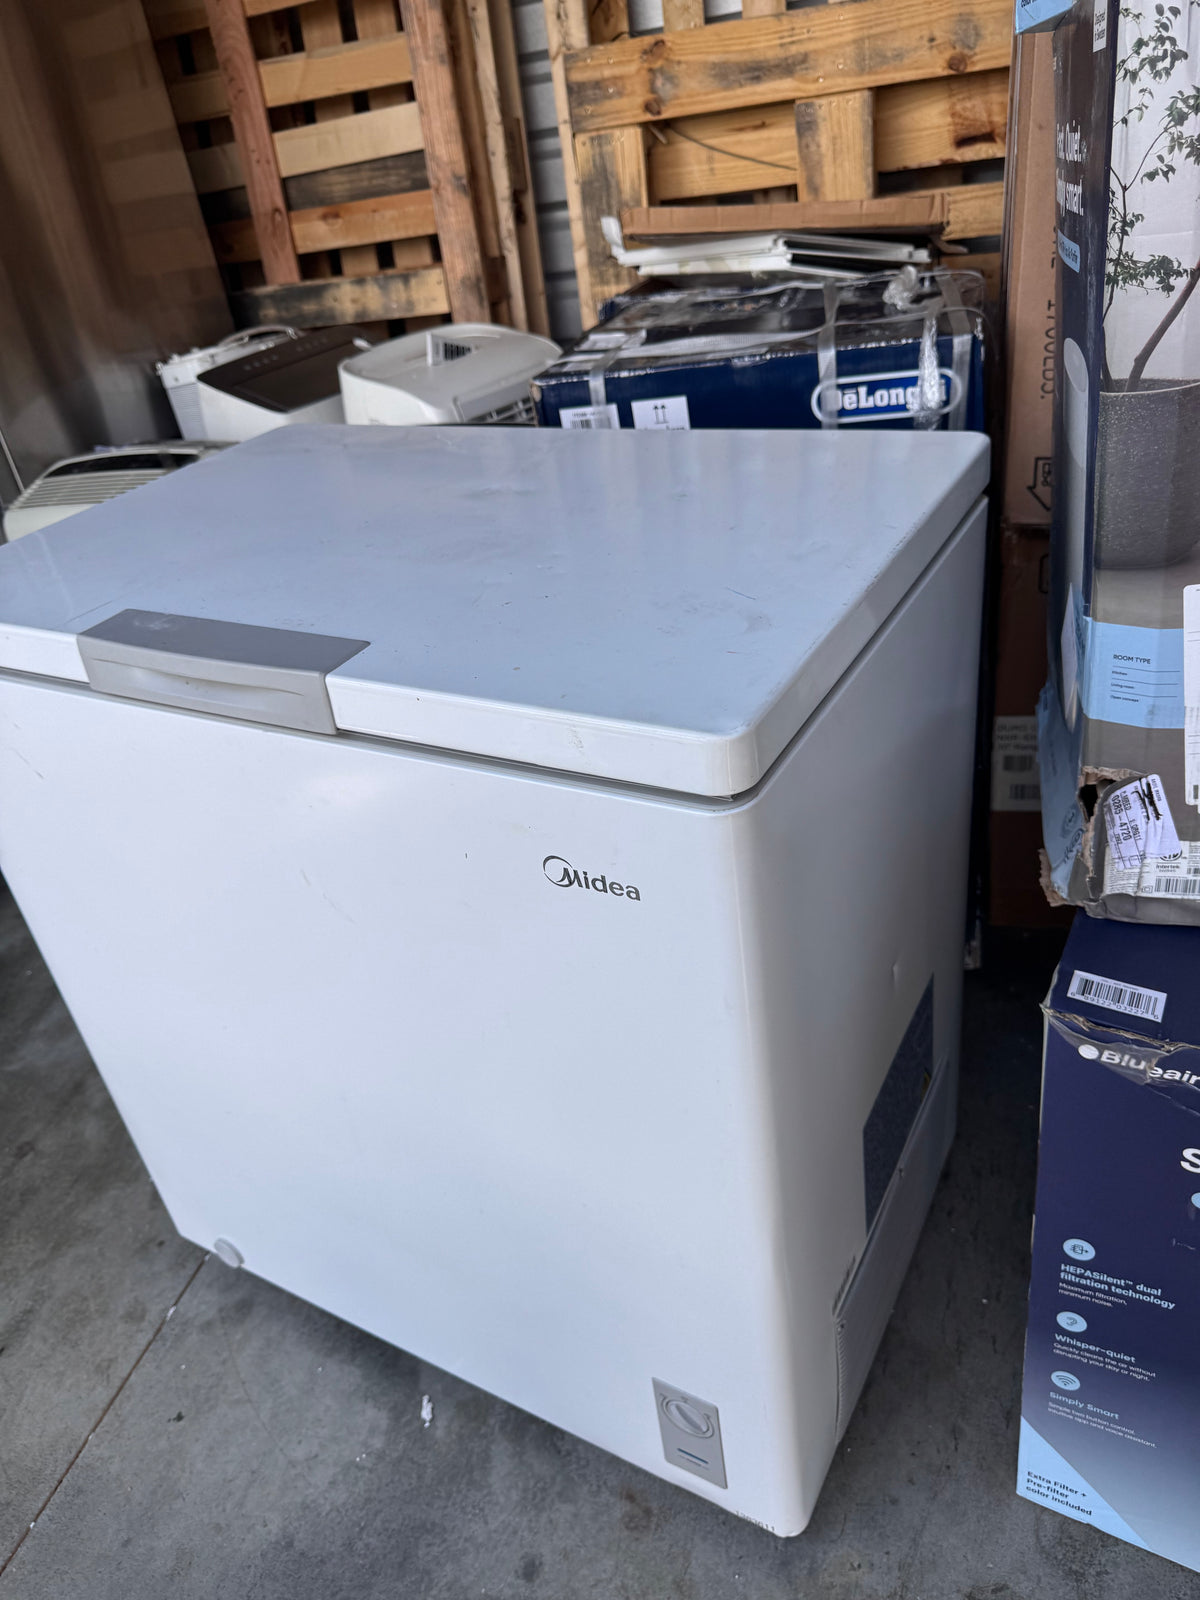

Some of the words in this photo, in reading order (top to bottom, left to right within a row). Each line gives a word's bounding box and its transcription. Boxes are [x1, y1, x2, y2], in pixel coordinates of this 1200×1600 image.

[1113, 654, 1134, 662] ROOM
[543, 855, 641, 902] Midea
[1059, 1282, 1094, 1296] Maximum
[1060, 1272, 1108, 1290] filtration
[1111, 1286, 1176, 1310] technology
[1136, 1284, 1162, 1296] dual
[1054, 1333, 1136, 1363] Whisper-quiet
[1054, 1342, 1079, 1354] Quickly
[1129, 1366, 1156, 1378] without
[1050, 1392, 1084, 1408] Simply
[1086, 1404, 1119, 1420] Smart
[1026, 1478, 1069, 1499] Pre-filter
[1028, 1471, 1051, 1484] Extra
[1054, 1481, 1078, 1494] Filter
[1026, 1486, 1050, 1498] color
[1052, 1495, 1092, 1516] included
